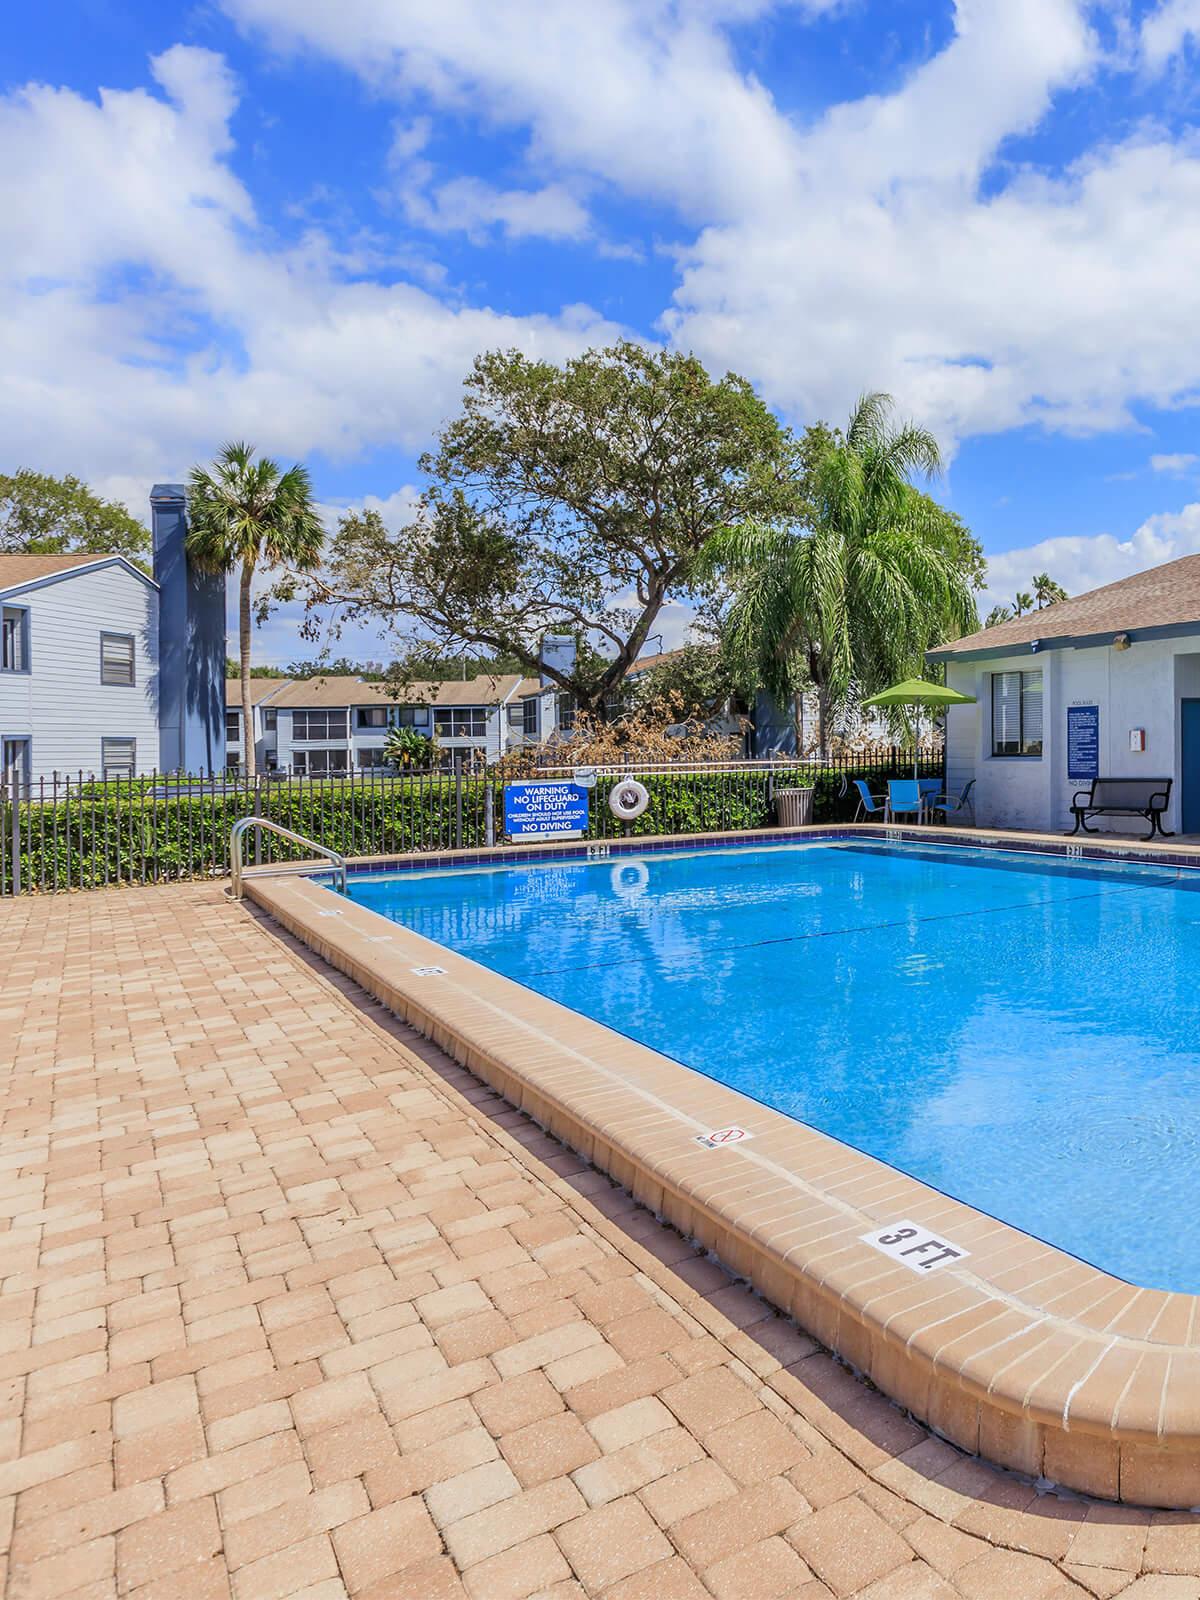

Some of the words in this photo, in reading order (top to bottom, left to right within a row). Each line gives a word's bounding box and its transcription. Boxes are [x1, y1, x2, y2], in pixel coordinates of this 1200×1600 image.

[525, 786, 569, 795] WARNING
[514, 796, 530, 804] NO
[532, 794, 579, 803] LIFEGUARD
[526, 803, 542, 811] ON
[544, 802, 568, 811] DUTY
[522, 824, 538, 832] NO
[540, 821, 572, 831] DIVING
[878, 1228, 918, 1245] 3
[900, 1240, 961, 1269] FT.
